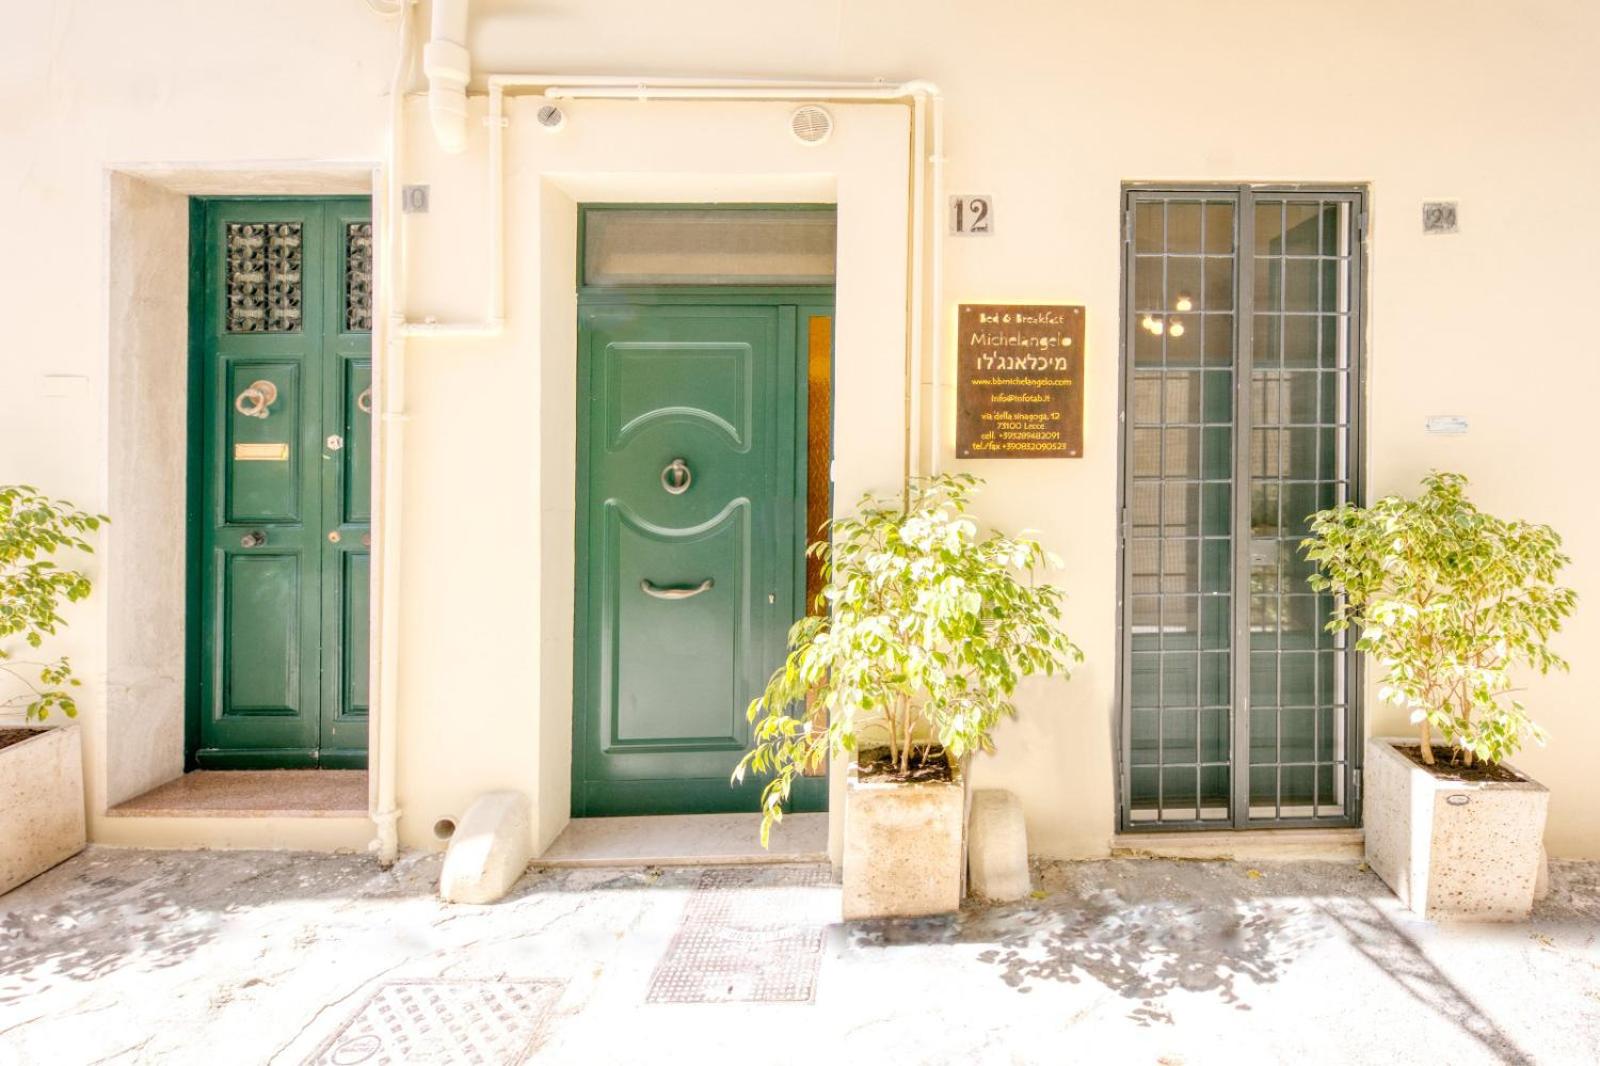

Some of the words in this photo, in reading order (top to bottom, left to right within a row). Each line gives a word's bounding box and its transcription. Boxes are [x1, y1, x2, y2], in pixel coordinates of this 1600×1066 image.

[954, 197, 990, 232] 12
[979, 313, 999, 324] Bed
[1016, 312, 1065, 324] Breakfast
[970, 332, 1072, 350] Michelangelo
[994, 411, 1012, 420] della
